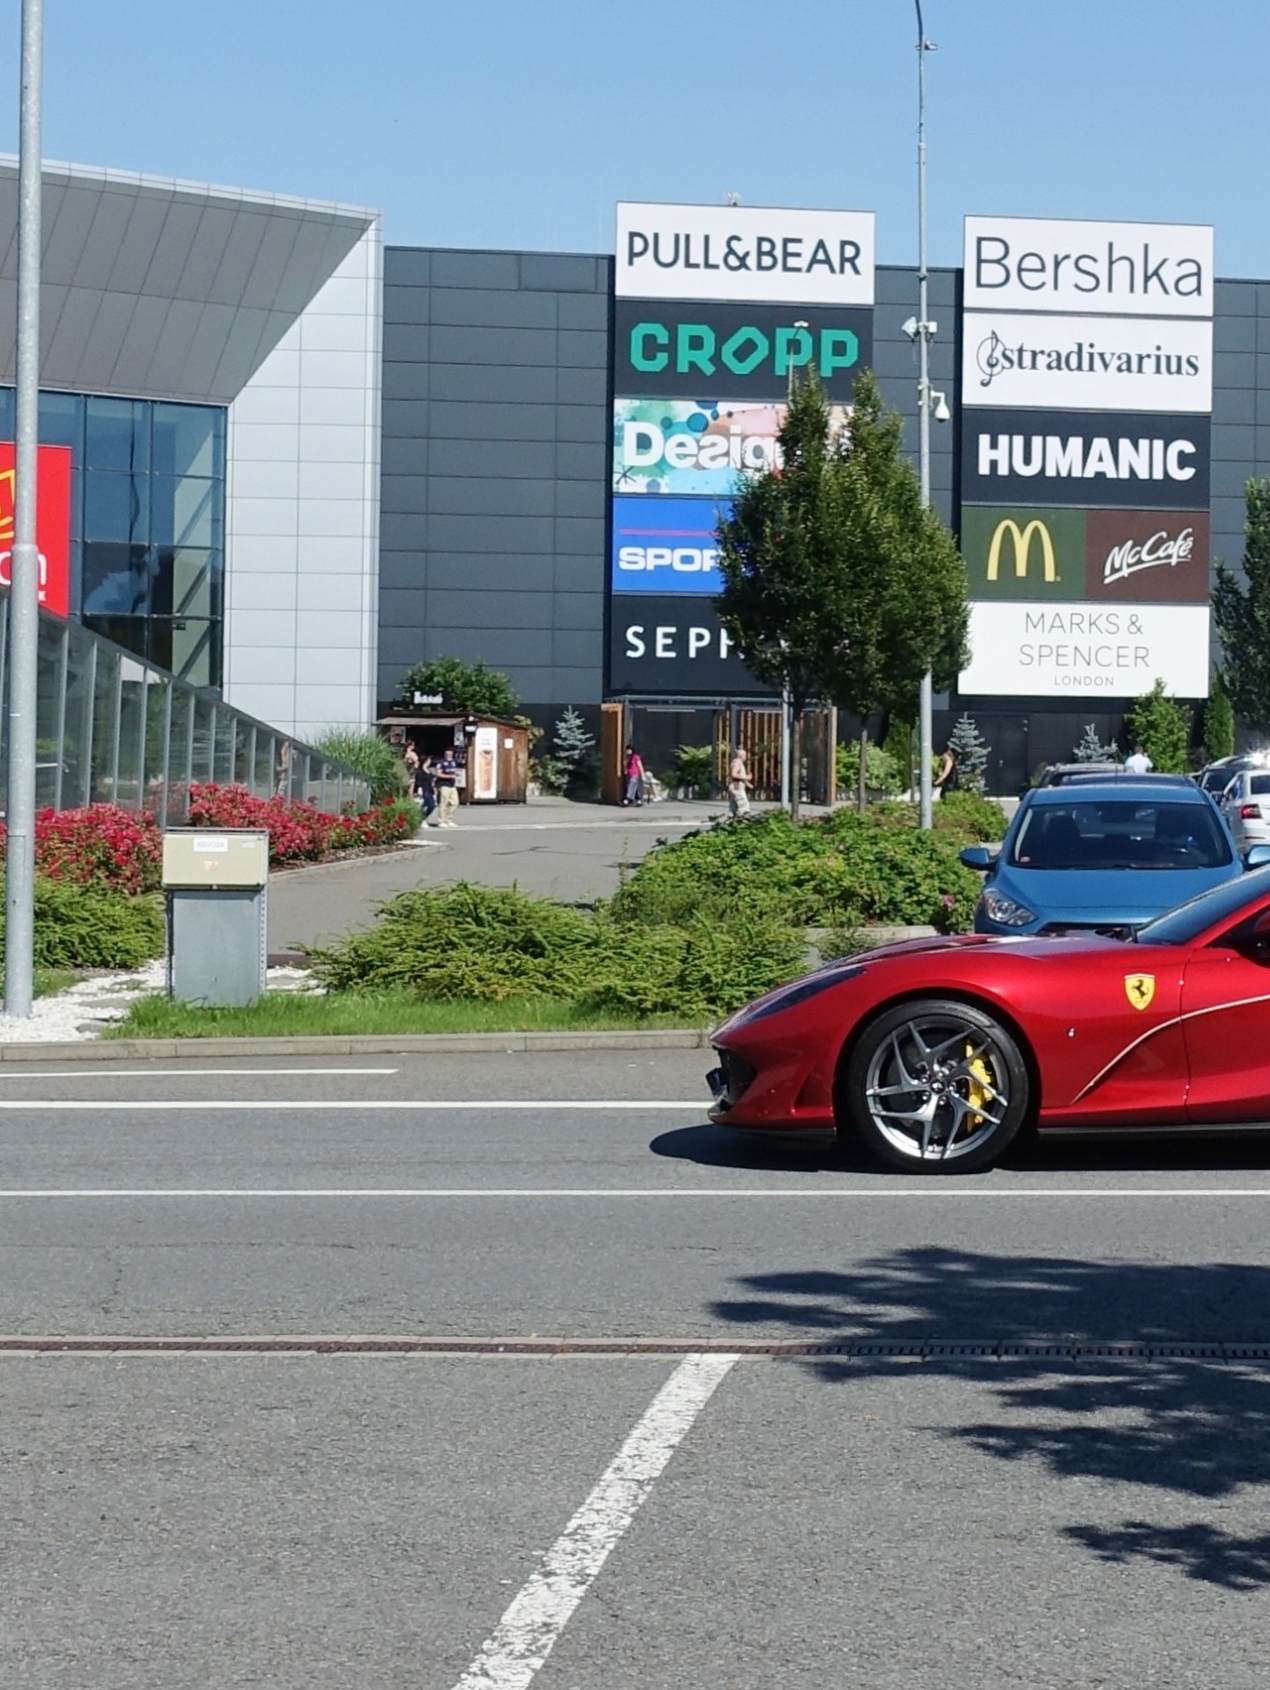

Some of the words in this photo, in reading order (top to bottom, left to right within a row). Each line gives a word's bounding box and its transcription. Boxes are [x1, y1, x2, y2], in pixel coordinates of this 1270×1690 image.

[627, 230, 862, 276] PULL&BEAR
[975, 236, 1203, 298] Bershka
[630, 322, 859, 377] CROPP
[977, 433, 1197, 481] HUMANIC
[1104, 527, 1195, 578] McCafé
[1024, 611, 1120, 635] MARKS
[1127, 612, 1144, 635] &
[1018, 643, 1150, 668] SPENCER
[1054, 674, 1114, 687] LONDON
